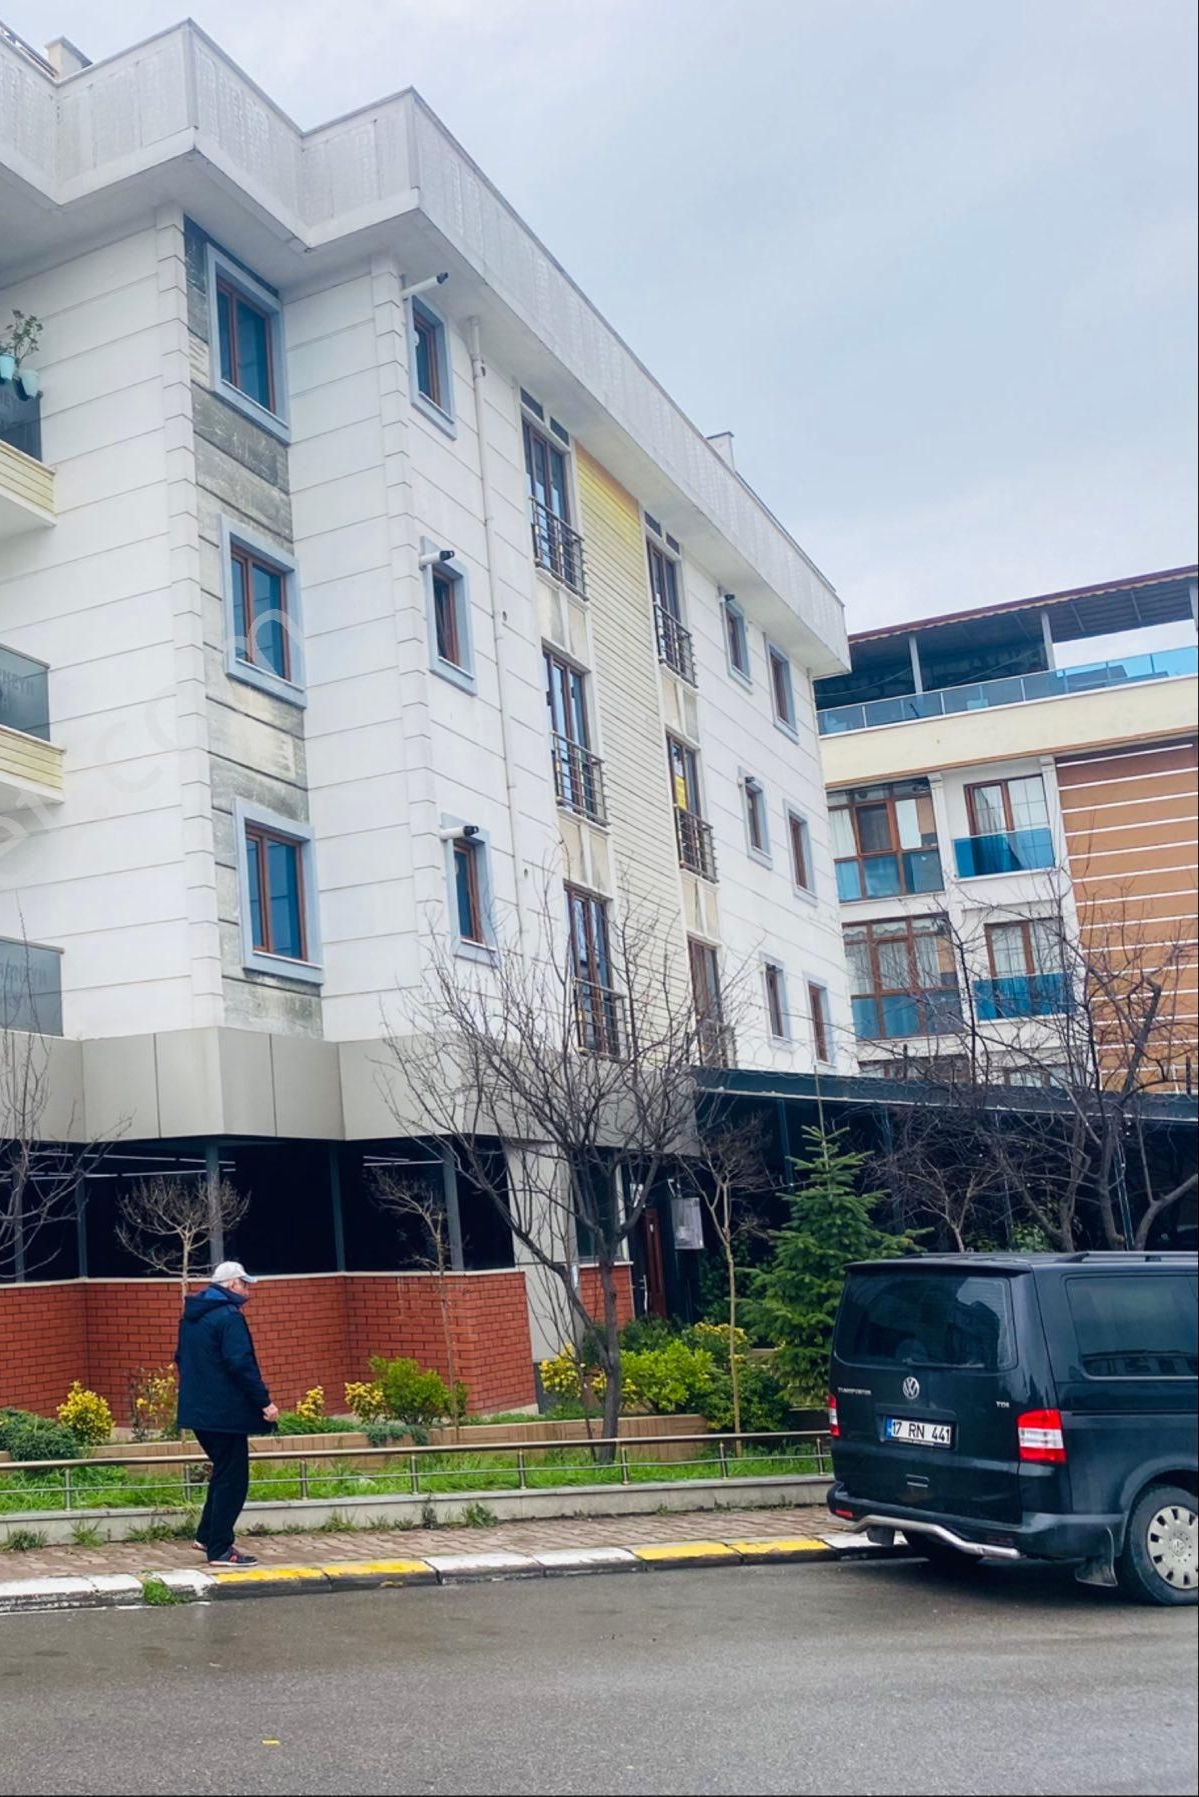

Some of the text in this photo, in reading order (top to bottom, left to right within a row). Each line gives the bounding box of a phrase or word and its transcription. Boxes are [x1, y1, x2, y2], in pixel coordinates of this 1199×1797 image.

[892, 1420, 903, 1436] 17
[908, 1423, 925, 1439] RN
[931, 1425, 951, 1443] 441
